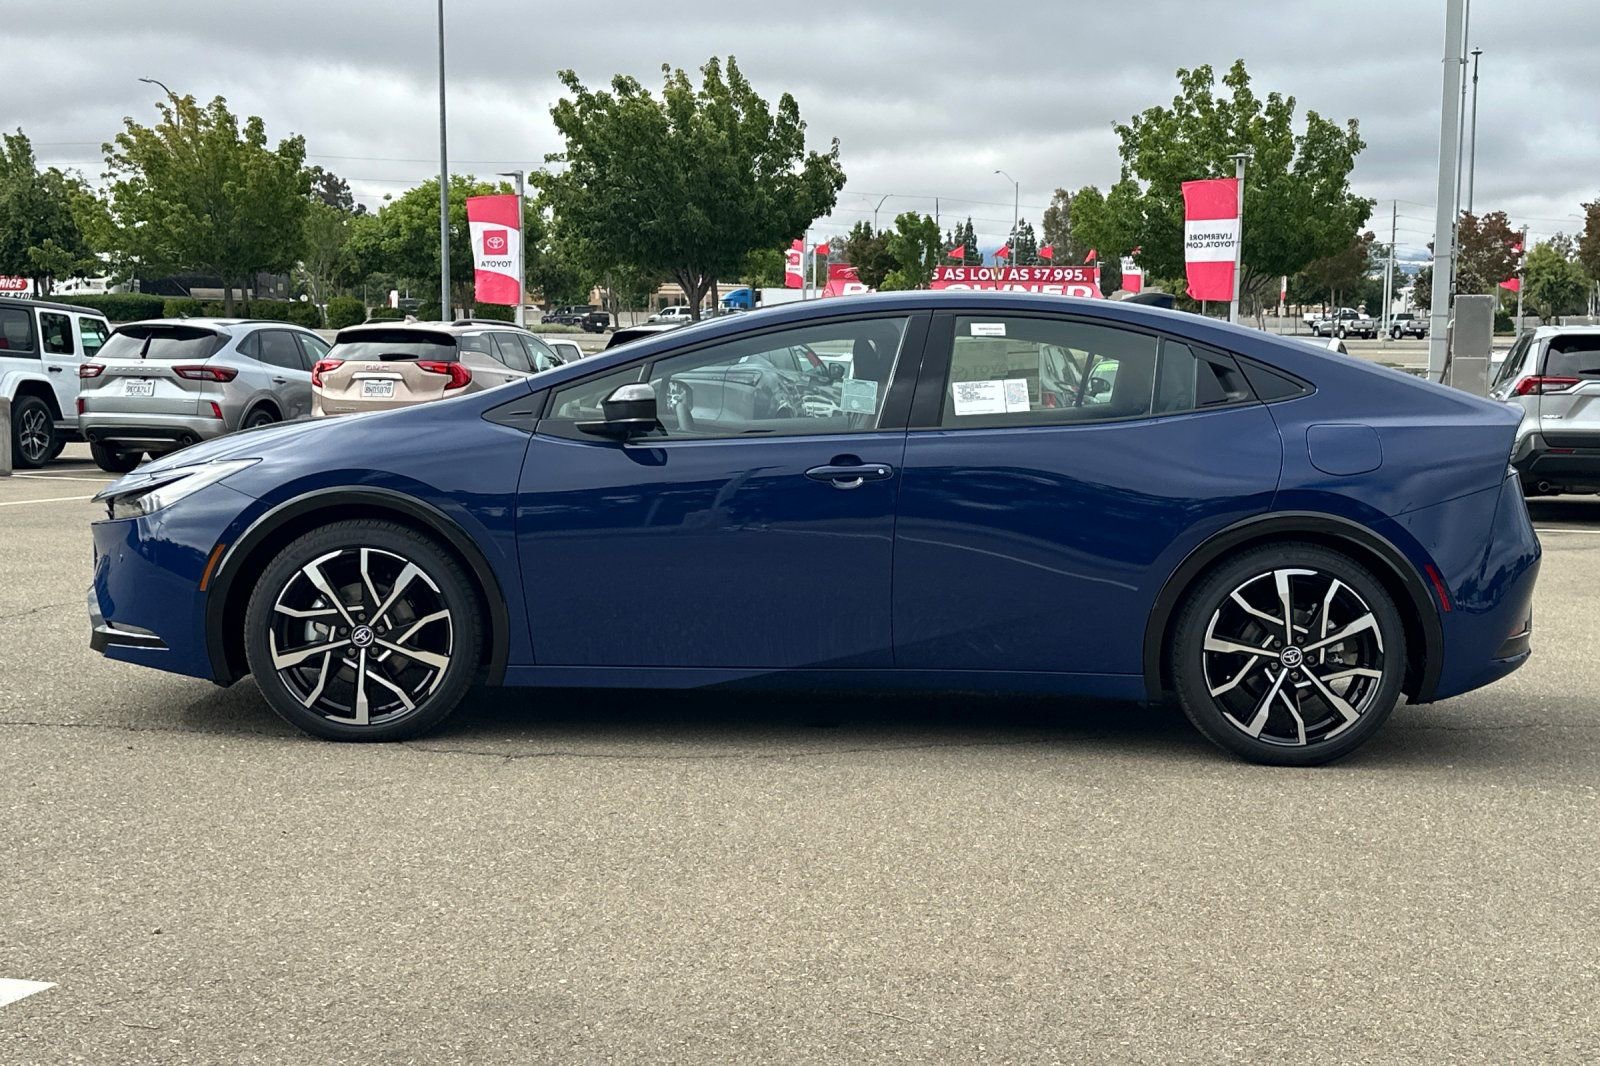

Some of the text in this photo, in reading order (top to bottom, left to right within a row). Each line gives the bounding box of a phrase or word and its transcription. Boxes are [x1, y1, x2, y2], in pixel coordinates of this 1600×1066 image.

[944, 268, 965, 281] AS
[970, 268, 1004, 281] LOW
[1008, 268, 1029, 281] AS
[1034, 268, 1087, 282] $7,995.
